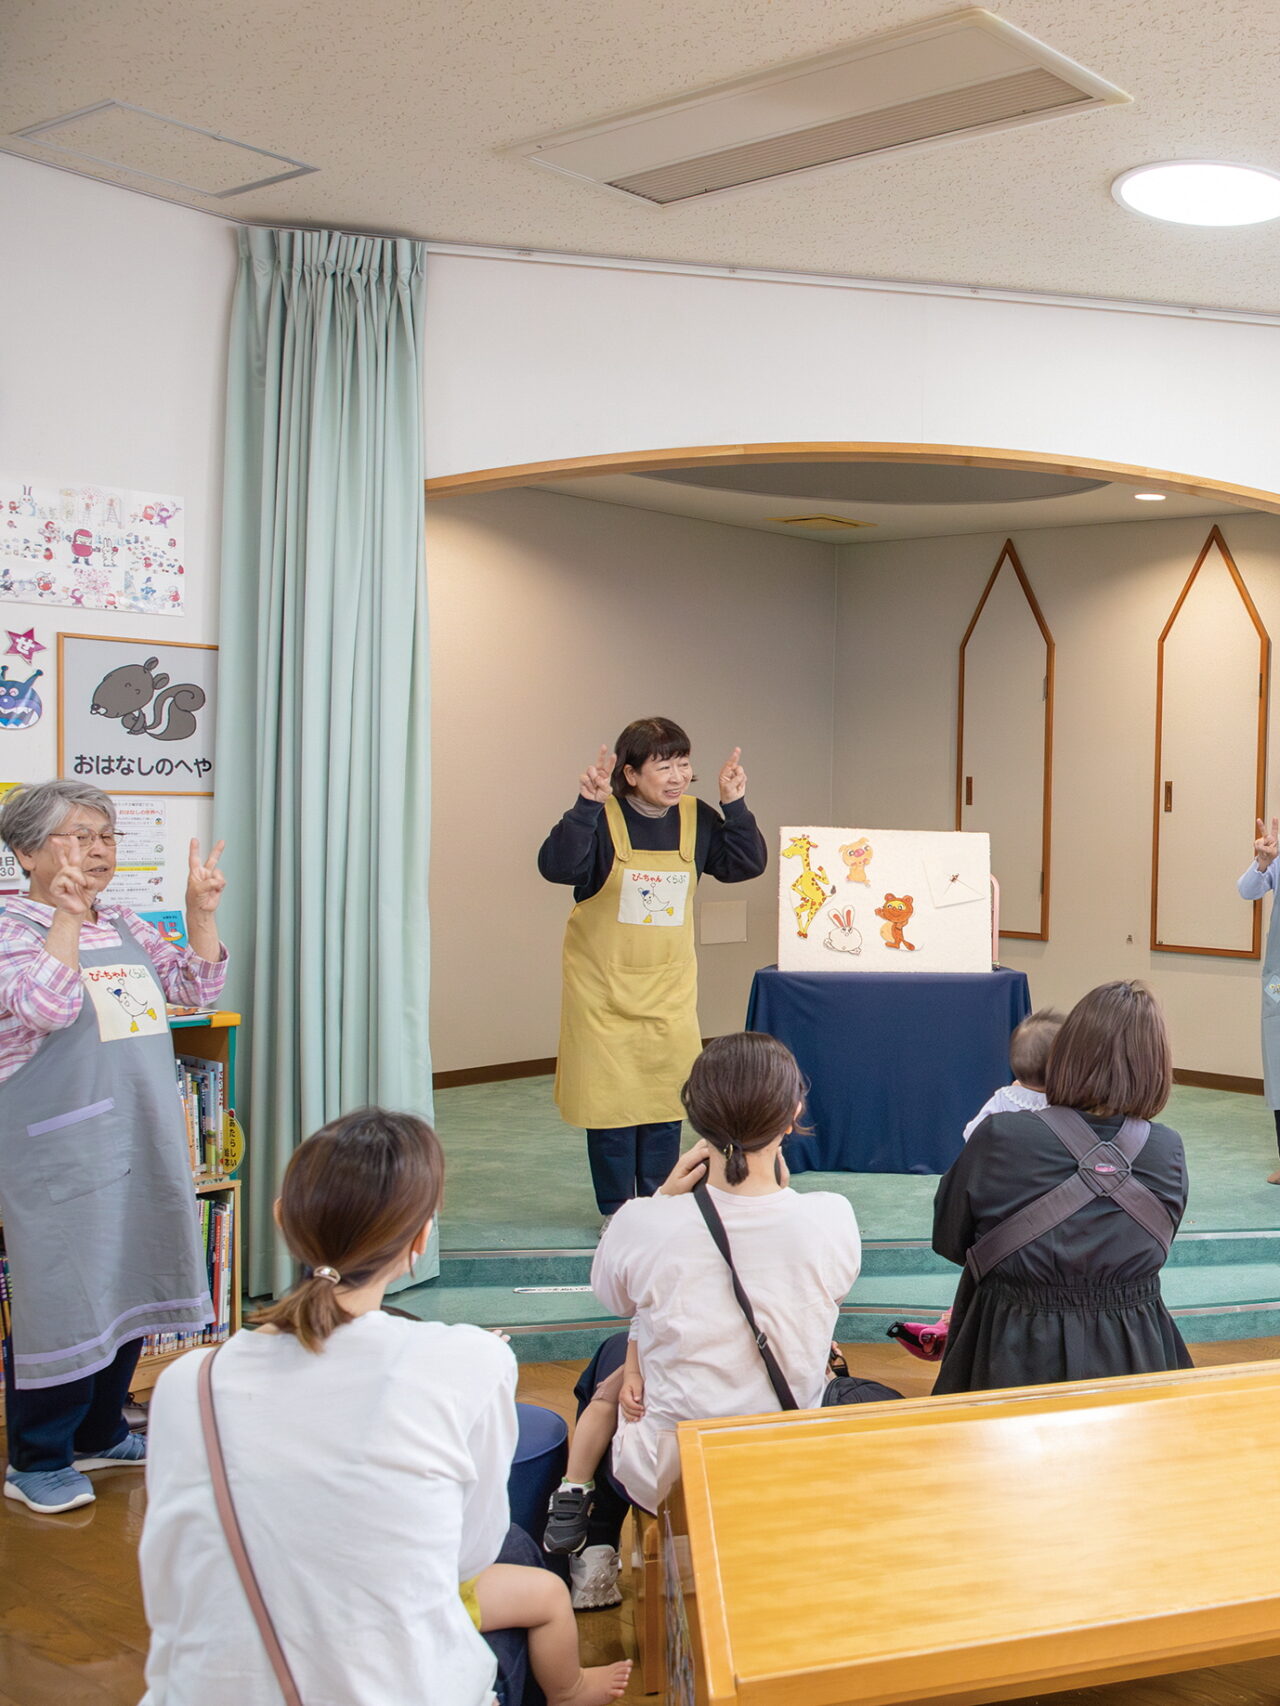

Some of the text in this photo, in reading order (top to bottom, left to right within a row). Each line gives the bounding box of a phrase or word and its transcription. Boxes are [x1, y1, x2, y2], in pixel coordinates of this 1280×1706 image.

[15, 637, 35, 655] せ
[73, 754, 212, 778] おはなしのへや
